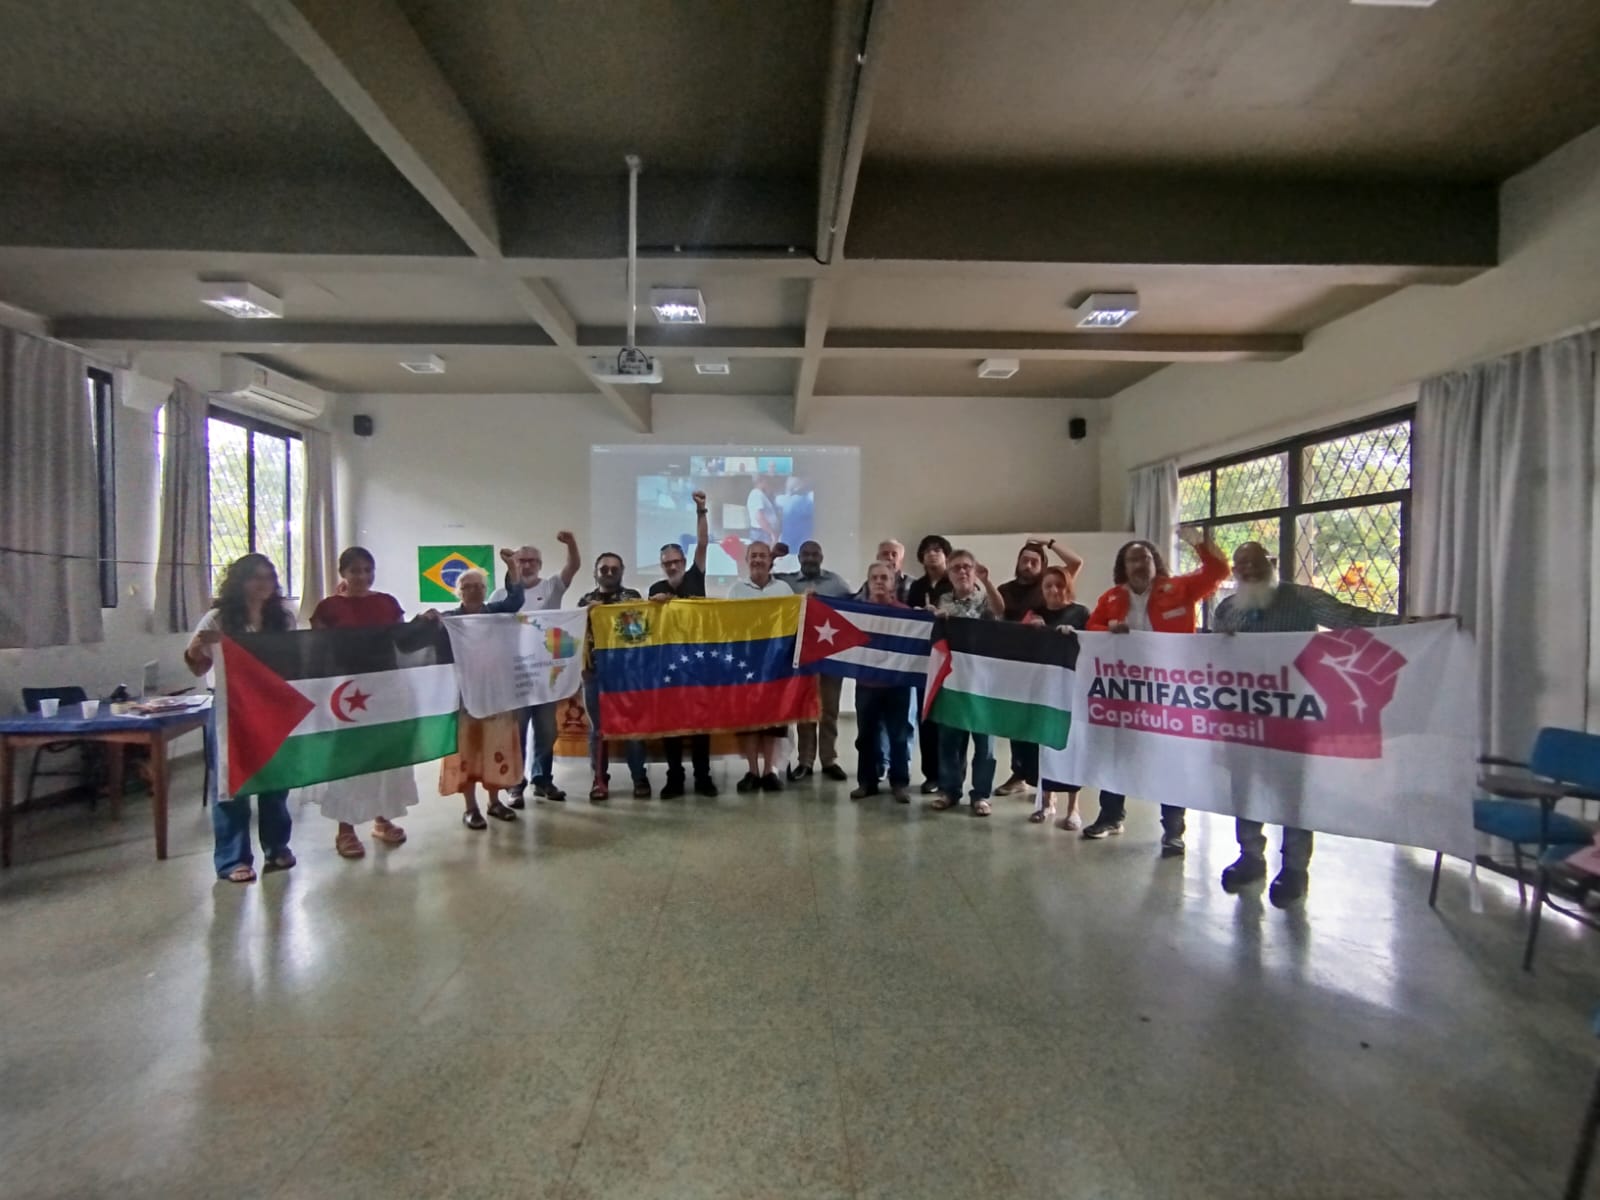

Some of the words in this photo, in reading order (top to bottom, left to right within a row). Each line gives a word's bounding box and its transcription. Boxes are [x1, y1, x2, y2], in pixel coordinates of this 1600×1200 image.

[1095, 657, 1289, 692] Internacional
[1087, 677, 1324, 721] ANTIFASCISTA
[1088, 703, 1184, 732] Capítulo
[1191, 714, 1265, 741] Brasil
